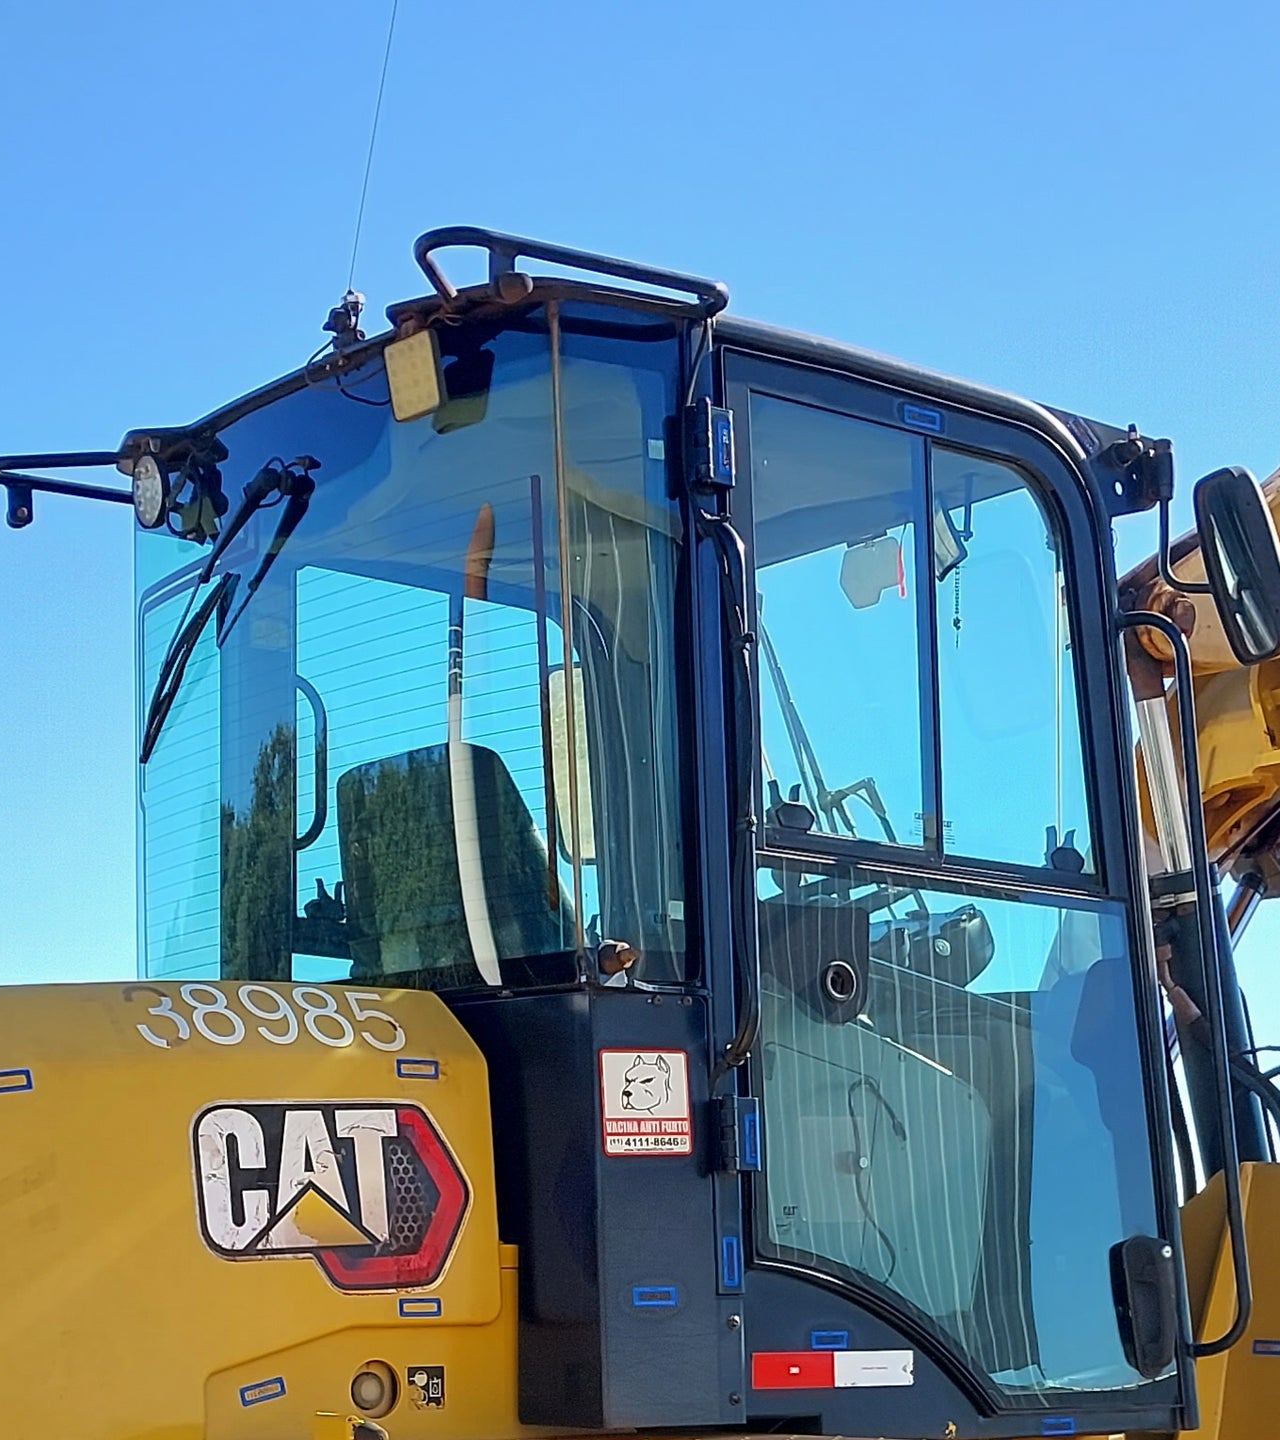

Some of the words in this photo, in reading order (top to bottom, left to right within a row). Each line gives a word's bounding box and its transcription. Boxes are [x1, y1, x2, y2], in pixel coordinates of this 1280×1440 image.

[123, 982, 407, 1052] 38985
[605, 1120, 639, 1133] VACINA
[640, 1120, 660, 1133] ANTI
[661, 1120, 689, 1133] FURTO
[198, 1107, 398, 1251] CAT
